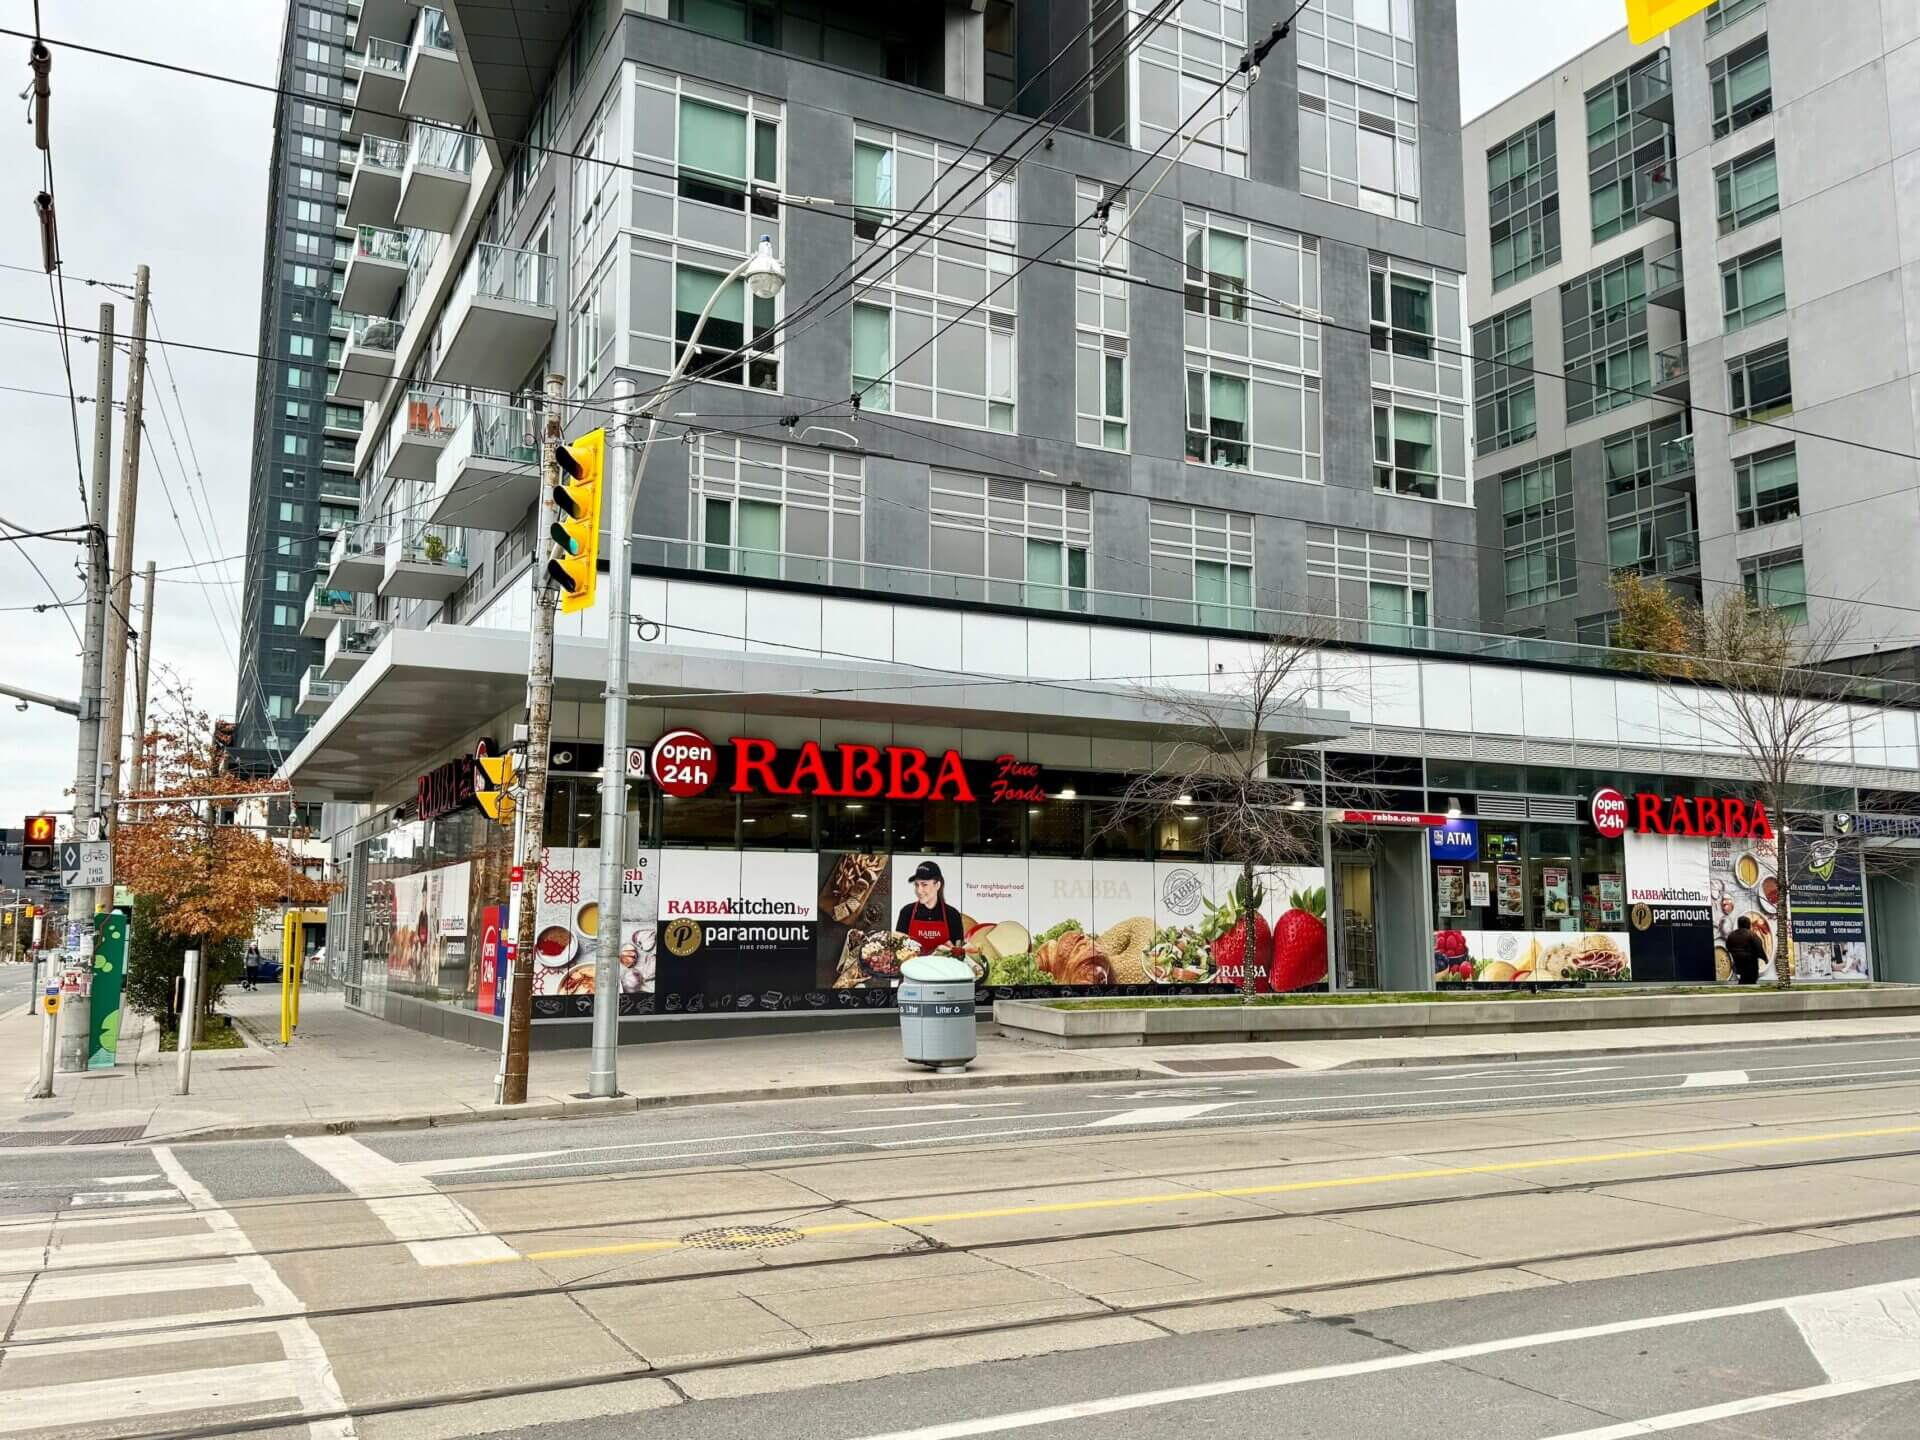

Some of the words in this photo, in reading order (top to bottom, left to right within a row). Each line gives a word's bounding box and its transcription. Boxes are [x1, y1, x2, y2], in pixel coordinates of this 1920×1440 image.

[663, 744, 711, 764] open
[729, 737, 977, 802] RABBA
[994, 754, 1039, 778] Fine
[663, 765, 708, 784] 24h
[991, 780, 1047, 803] Foods
[1597, 799, 1625, 811] open
[1372, 813, 1420, 823] rabba.com
[1599, 813, 1624, 829] 24h
[1634, 793, 1775, 839] RABBA
[1446, 832, 1472, 846] ATM
[1710, 841, 1731, 849] made
[1711, 850, 1730, 858] fresh
[88, 867, 103, 875] THIS
[1711, 860, 1730, 868] daily
[86, 876, 105, 884] LANE
[1053, 879, 1132, 899] RABBA
[1162, 877, 1202, 912] RABBA
[798, 905, 809, 915] by
[1653, 908, 1710, 923] paramount
[705, 925, 810, 946] paramount
[935, 1005, 953, 1014] Litter
